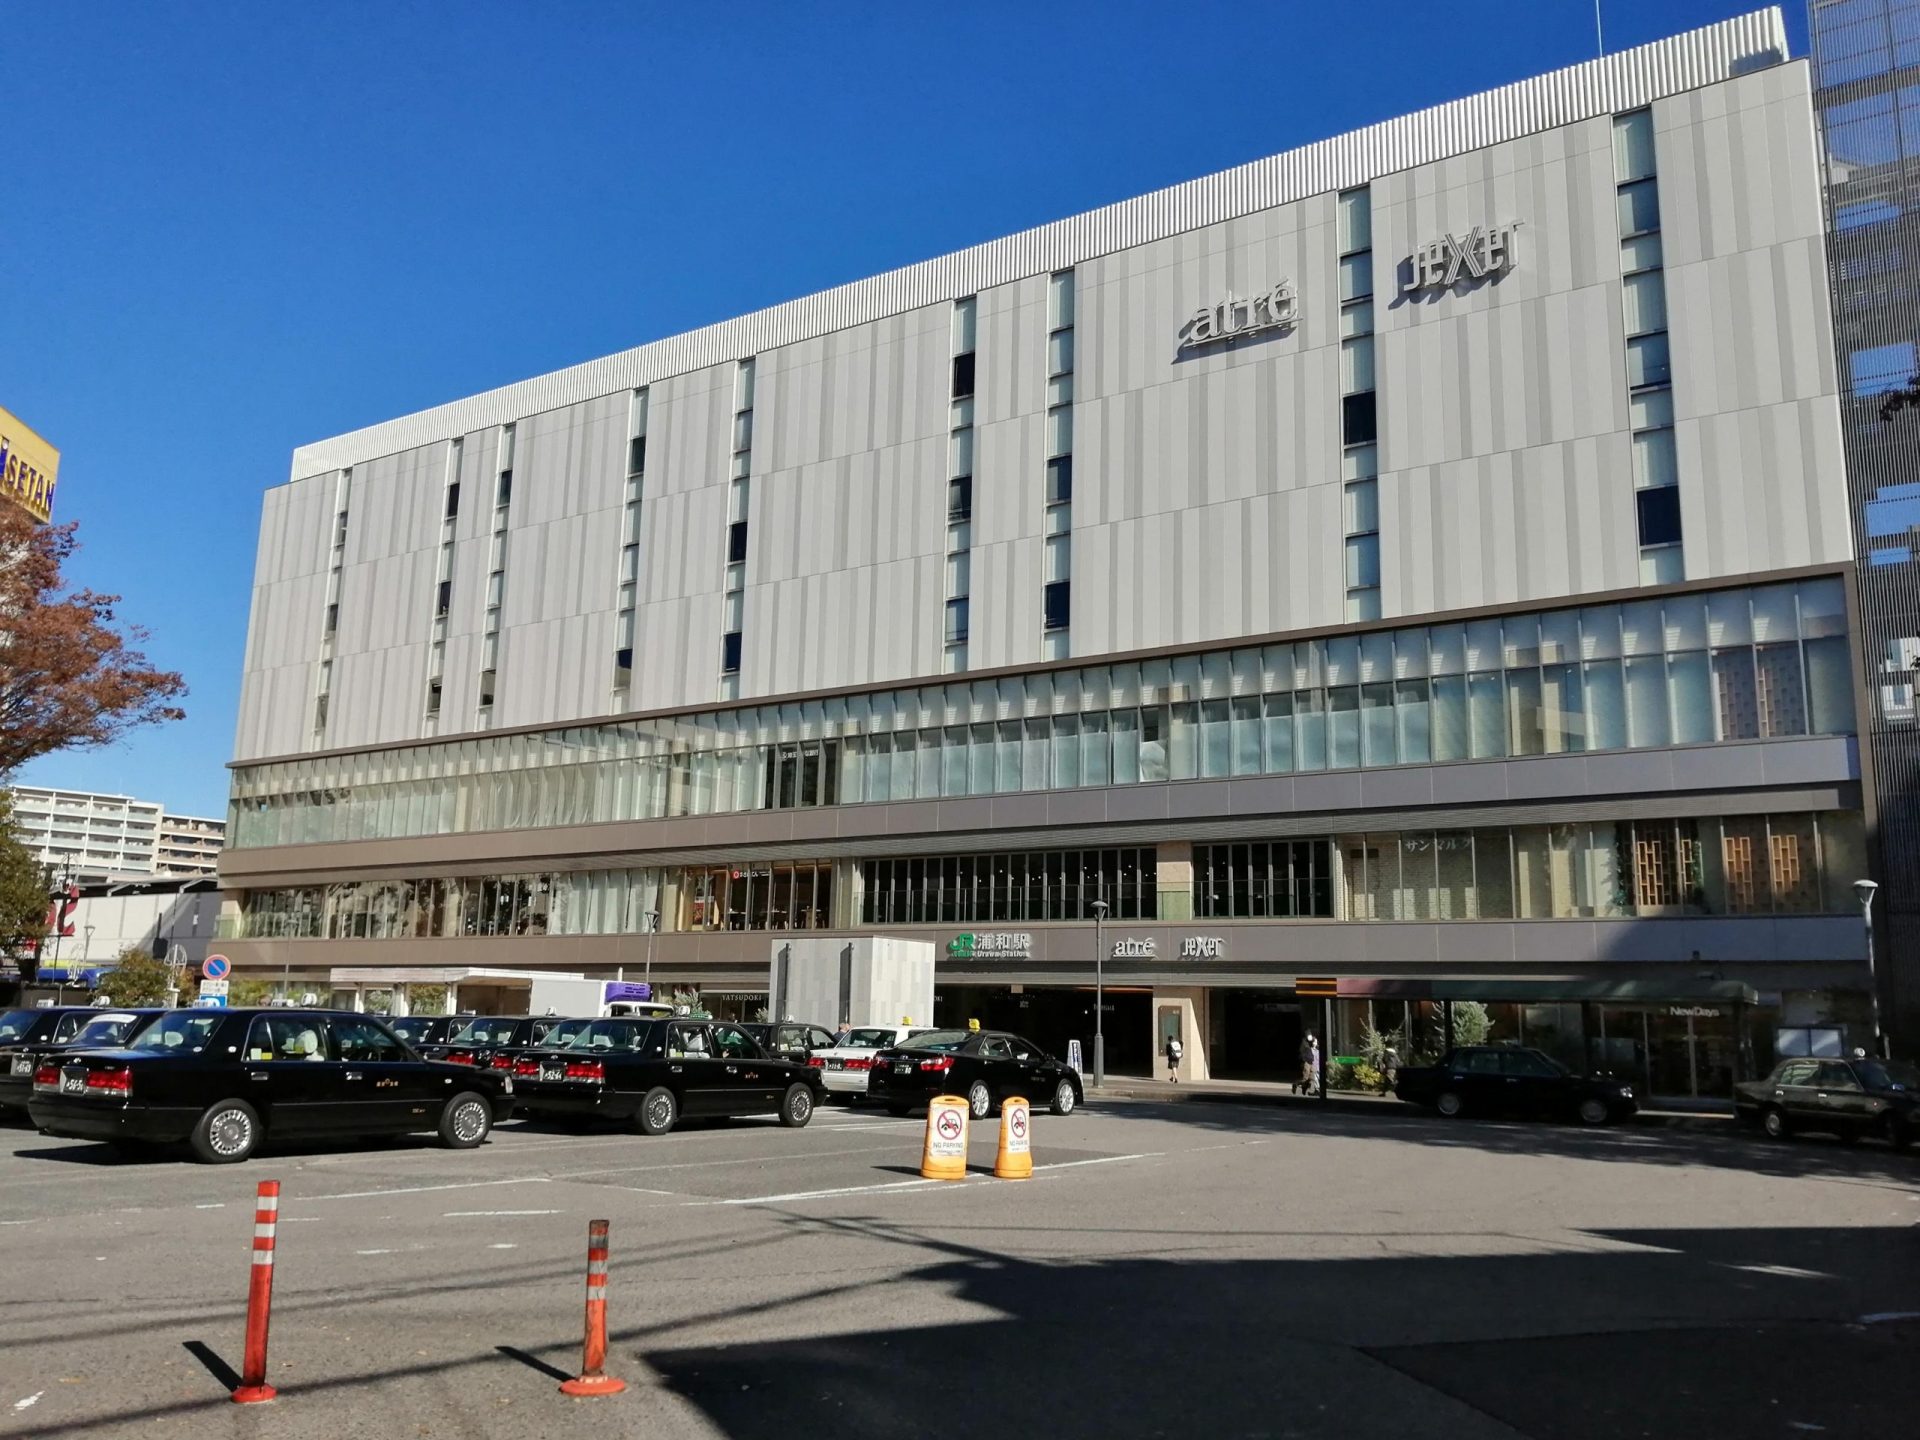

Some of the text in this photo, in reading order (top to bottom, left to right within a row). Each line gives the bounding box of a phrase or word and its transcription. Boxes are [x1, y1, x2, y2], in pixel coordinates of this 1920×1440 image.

[1188, 278, 1301, 345] atré
[950, 932, 1032, 951] JR 浦和駅
[1113, 937, 1155, 957] atré
[1669, 1006, 1720, 1017] NewDays
